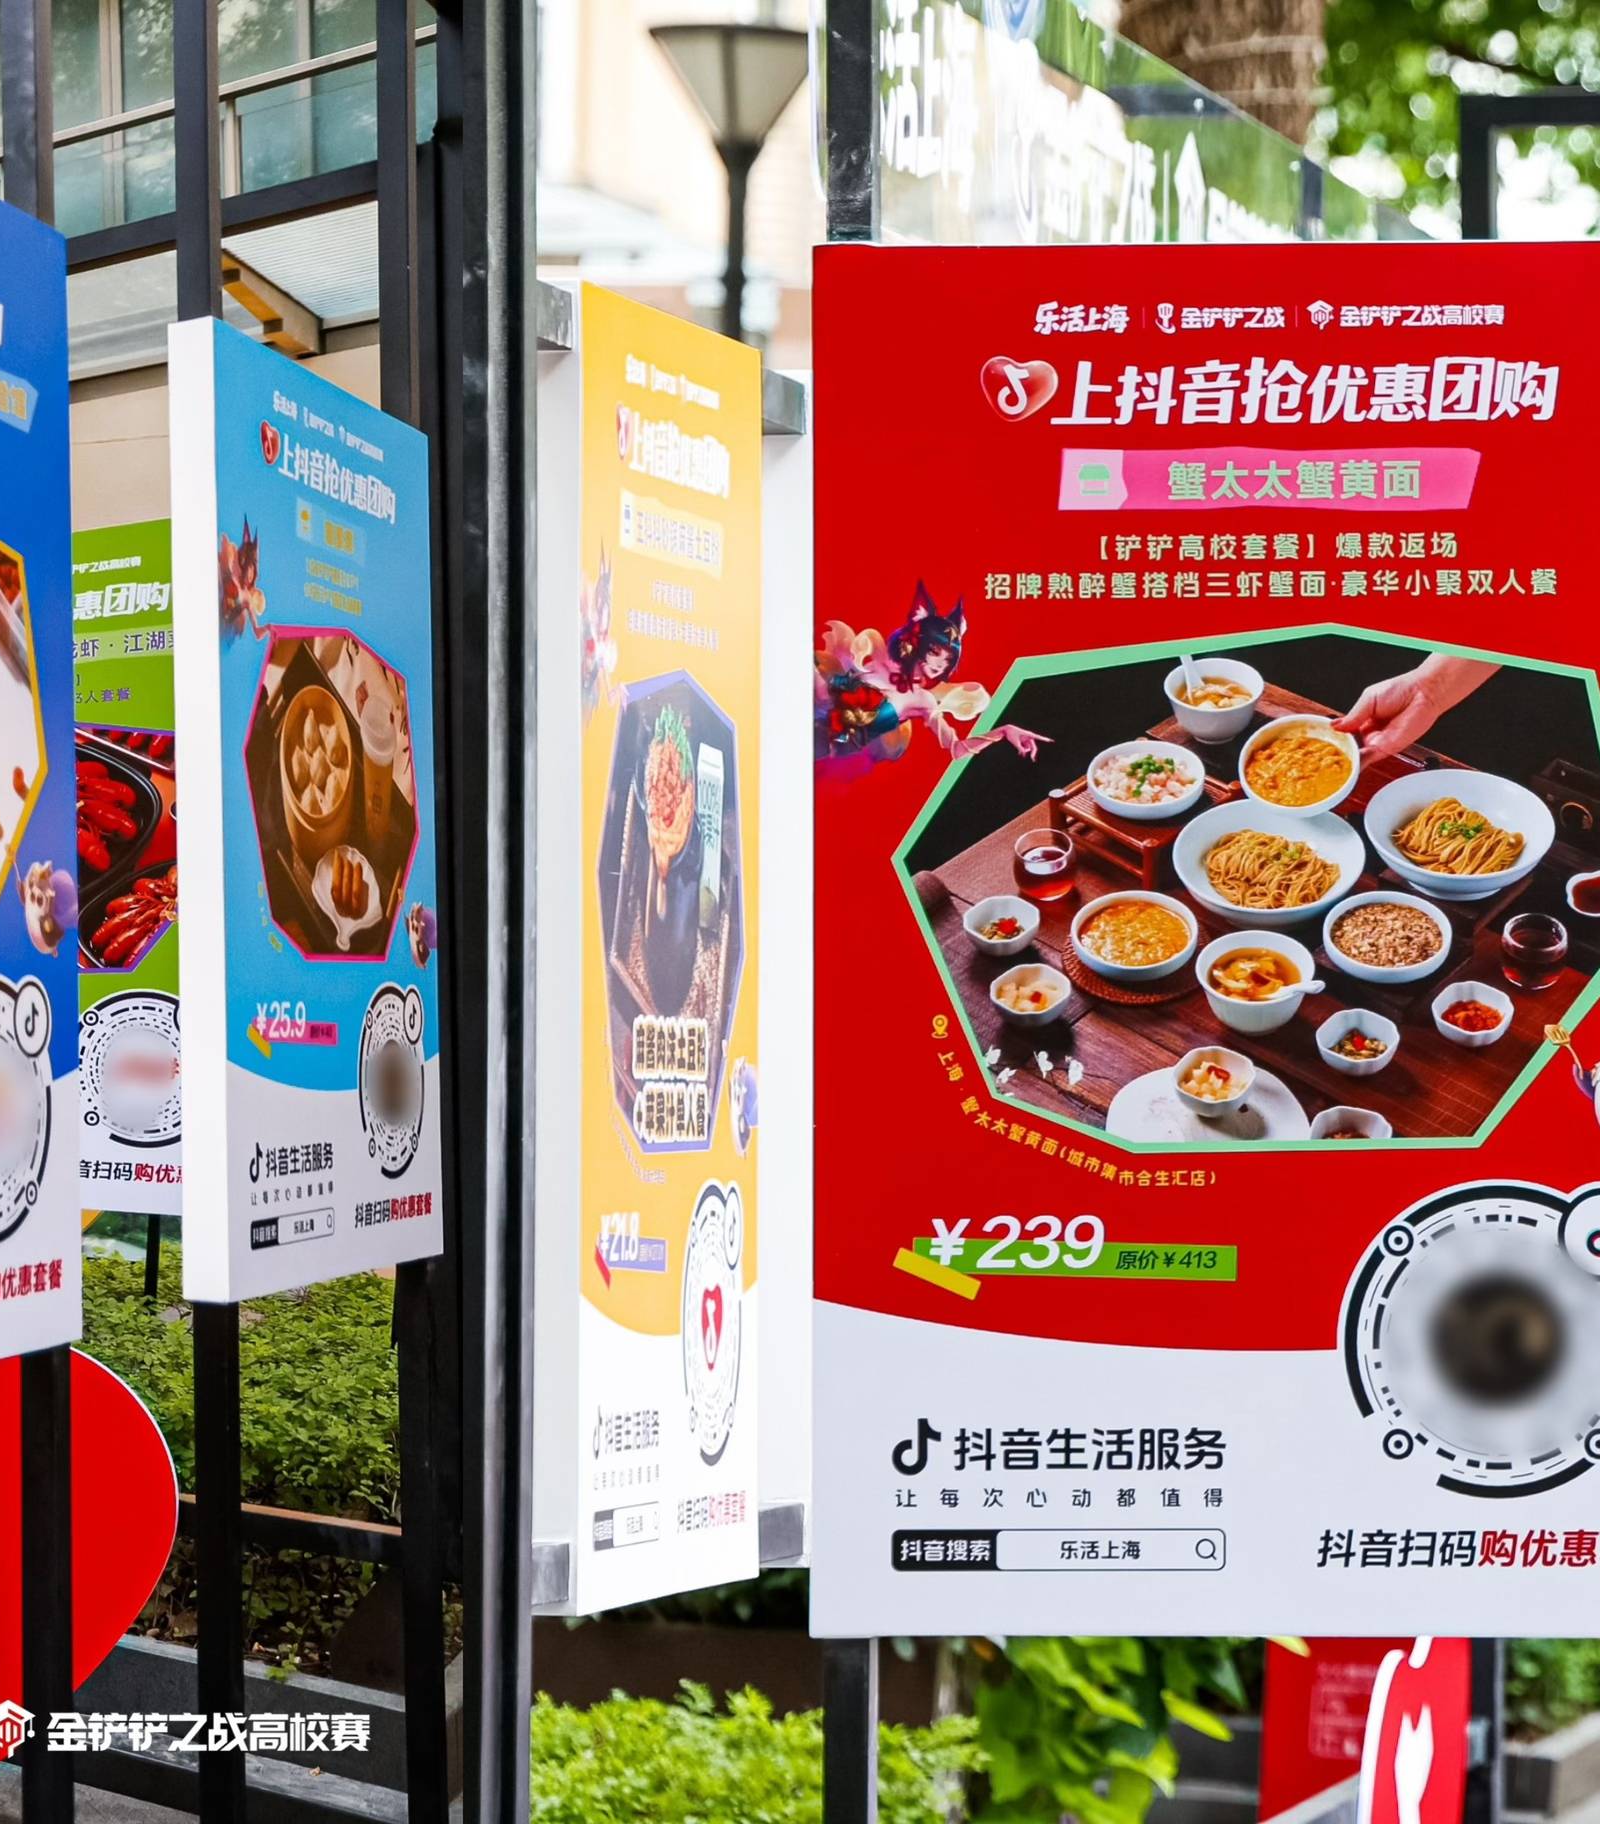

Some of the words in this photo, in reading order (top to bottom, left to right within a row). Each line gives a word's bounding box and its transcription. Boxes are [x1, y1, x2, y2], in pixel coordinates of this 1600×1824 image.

[1034, 301, 1130, 335] 乐活上海
[1180, 306, 1287, 331] 金铲铲之战
[1340, 302, 1507, 329] 金铲铲之战高校赛
[1050, 356, 1561, 426] 上抖音抢优惠团购
[278, 433, 396, 525] 上抖音抢优惠团购
[1167, 459, 1423, 503] 蟹太太蟹黄面
[1335, 530, 1459, 561] 爆款返场
[266, 1142, 334, 1179] 抖音生活服务
[354, 1191, 433, 1229] 抖音扫码购优惠套餐
[929, 1214, 1105, 1270] ¥239
[954, 1427, 1228, 1473] 抖音生活服务
[899, 1539, 992, 1564] 抖音搜索
[1059, 1539, 1142, 1563] 乐活上海
